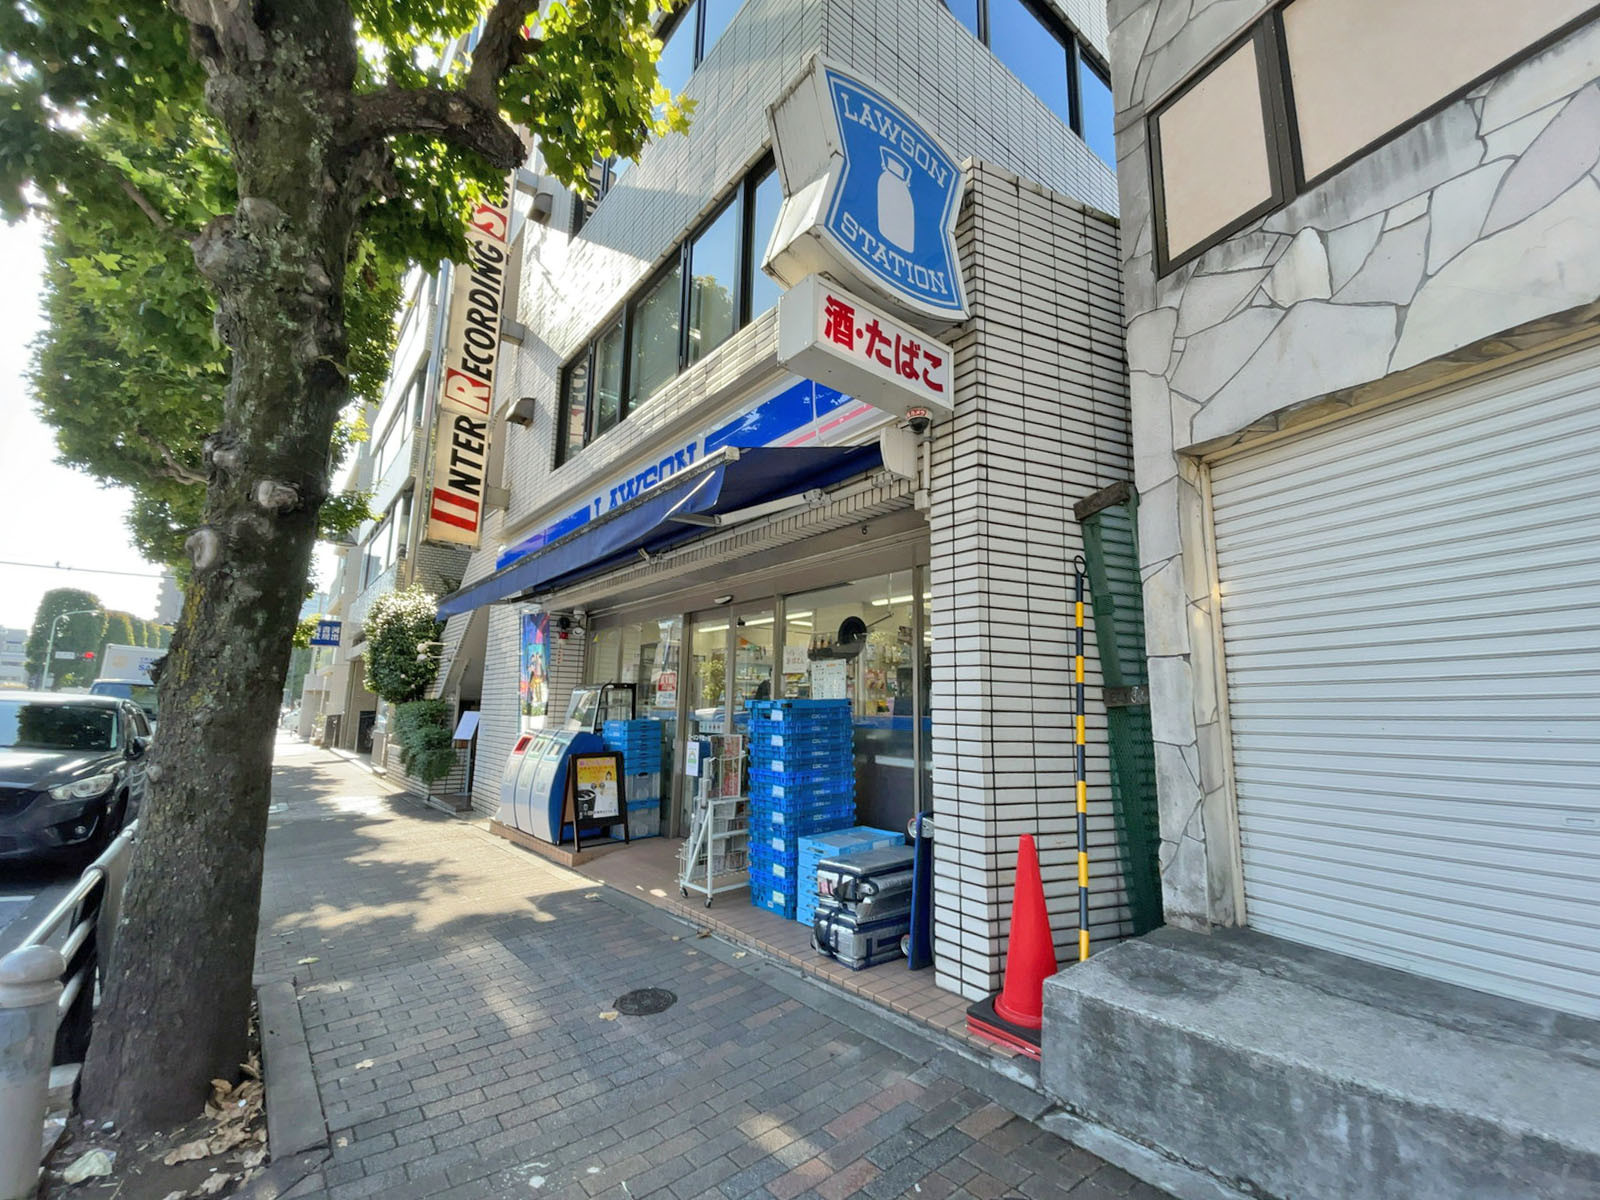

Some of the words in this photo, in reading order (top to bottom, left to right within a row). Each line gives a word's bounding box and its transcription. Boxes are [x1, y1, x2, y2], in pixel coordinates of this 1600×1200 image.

[841, 93, 948, 188] LAWSON
[840, 211, 948, 295] STATION
[446, 240, 504, 414] RECORDING
[824, 294, 944, 392] 酒・たばこ
[432, 414, 487, 532] INTER
